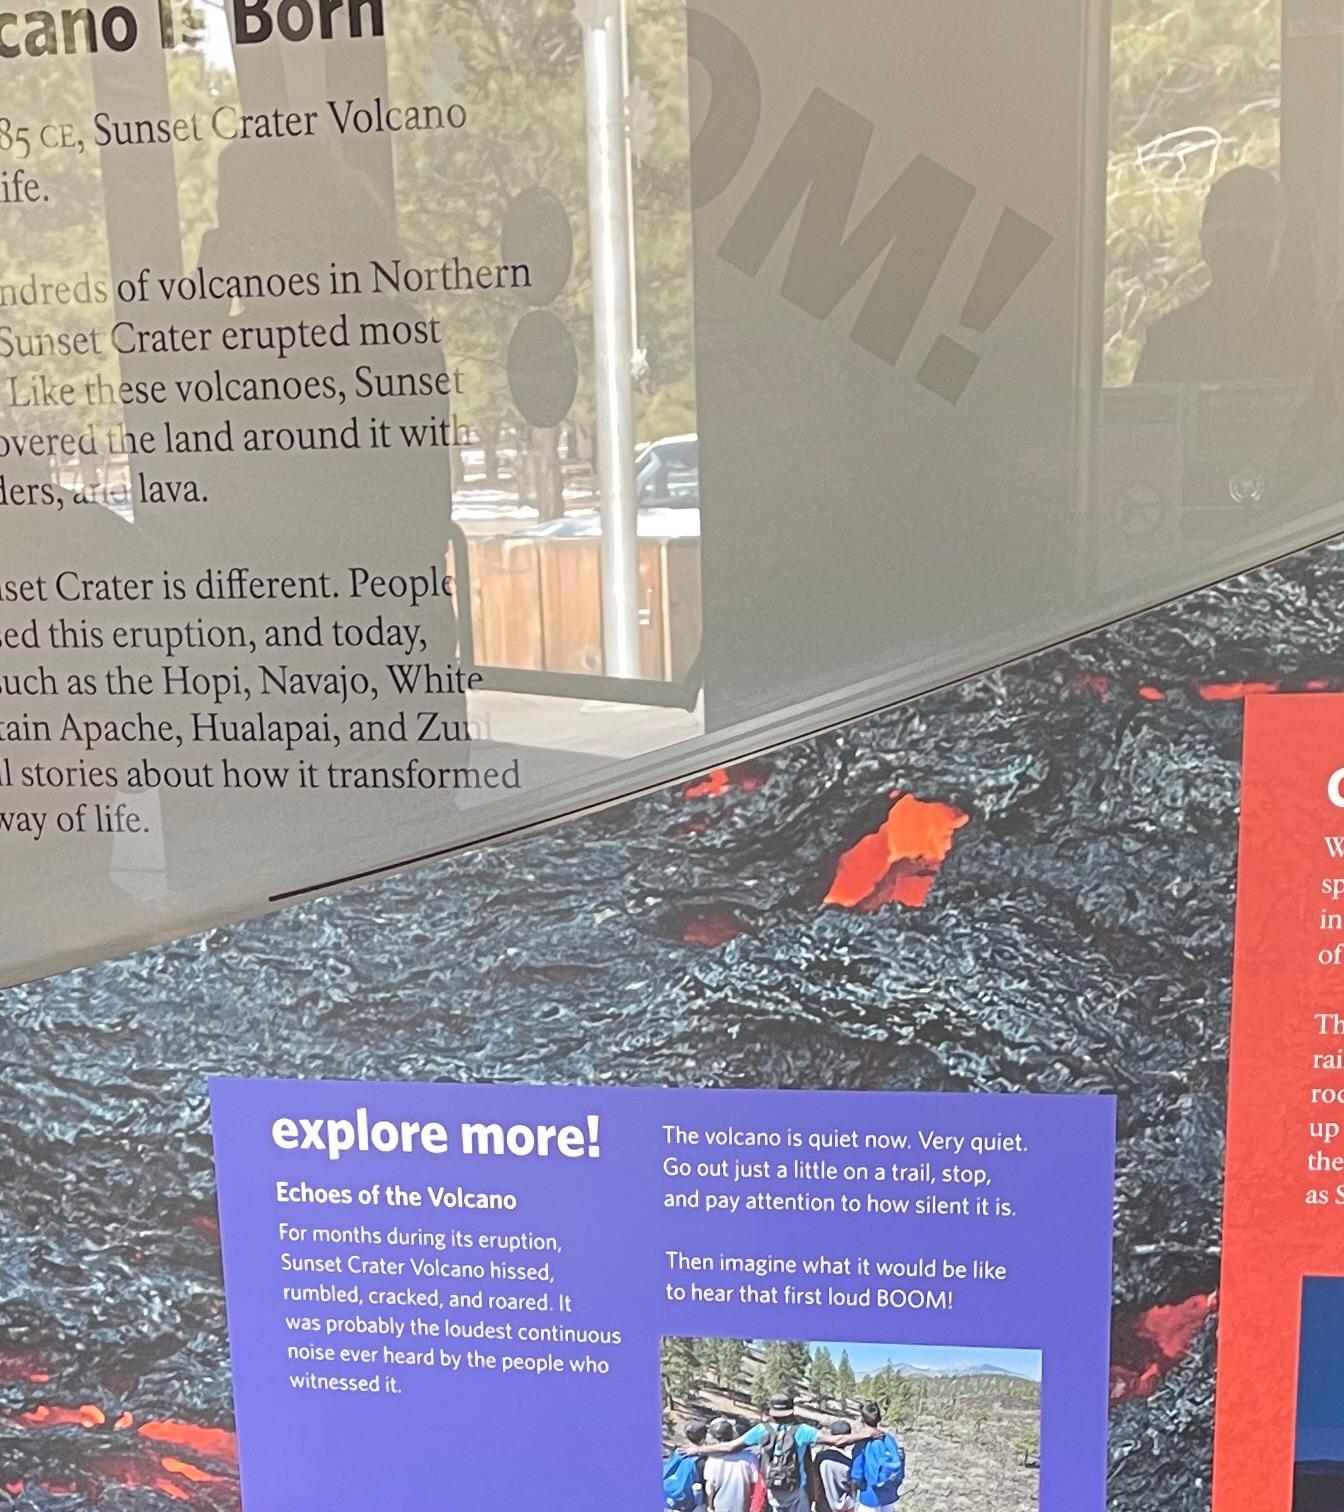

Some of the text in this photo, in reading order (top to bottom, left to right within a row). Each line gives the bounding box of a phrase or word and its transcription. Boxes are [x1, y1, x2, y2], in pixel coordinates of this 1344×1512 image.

[233, 0, 384, 45] Born
[40, 125, 84, 153] CE,
[94, 112, 203, 146] Sunset
[212, 106, 318, 139] Crater
[327, 97, 466, 134] Volcano
[118, 269, 150, 302] of
[158, 267, 319, 300] volcanoes
[330, 263, 362, 294] in
[370, 257, 532, 293] Northern
[111, 322, 212, 354] Crater
[223, 313, 350, 359] erupted
[360, 317, 441, 346] most
[56, 571, 153, 600] Crater
[163, 571, 186, 600] is
[196, 568, 338, 599] different.
[348, 565, 456, 607] People
[48, 619, 103, 648] this
[113, 618, 256, 656] eruption,
[266, 616, 323, 646] and
[332, 615, 426, 655] today,
[68, 675, 96, 695] as
[106, 665, 153, 695] the
[162, 666, 250, 704] Hopi,
[259, 665, 377, 704] Navajo,
[386, 663, 484, 694] White
[1319, 943, 1344, 964] of
[272, 1108, 599, 1160] explore more!
[662, 1126, 1027, 1154] The volcano is quiet now. Very quiet.
[277, 1182, 516, 1209] Echoes of the Volcano
[1306, 1190, 1328, 1204] as
[280, 1223, 561, 1253] For months during its eruption,
[281, 1253, 554, 1283] Sunset Crater Volcano hissed,
[666, 1283, 952, 1309] to hear that first loud BOOM!
[286, 1316, 621, 1344] was probably the loudest continuous
